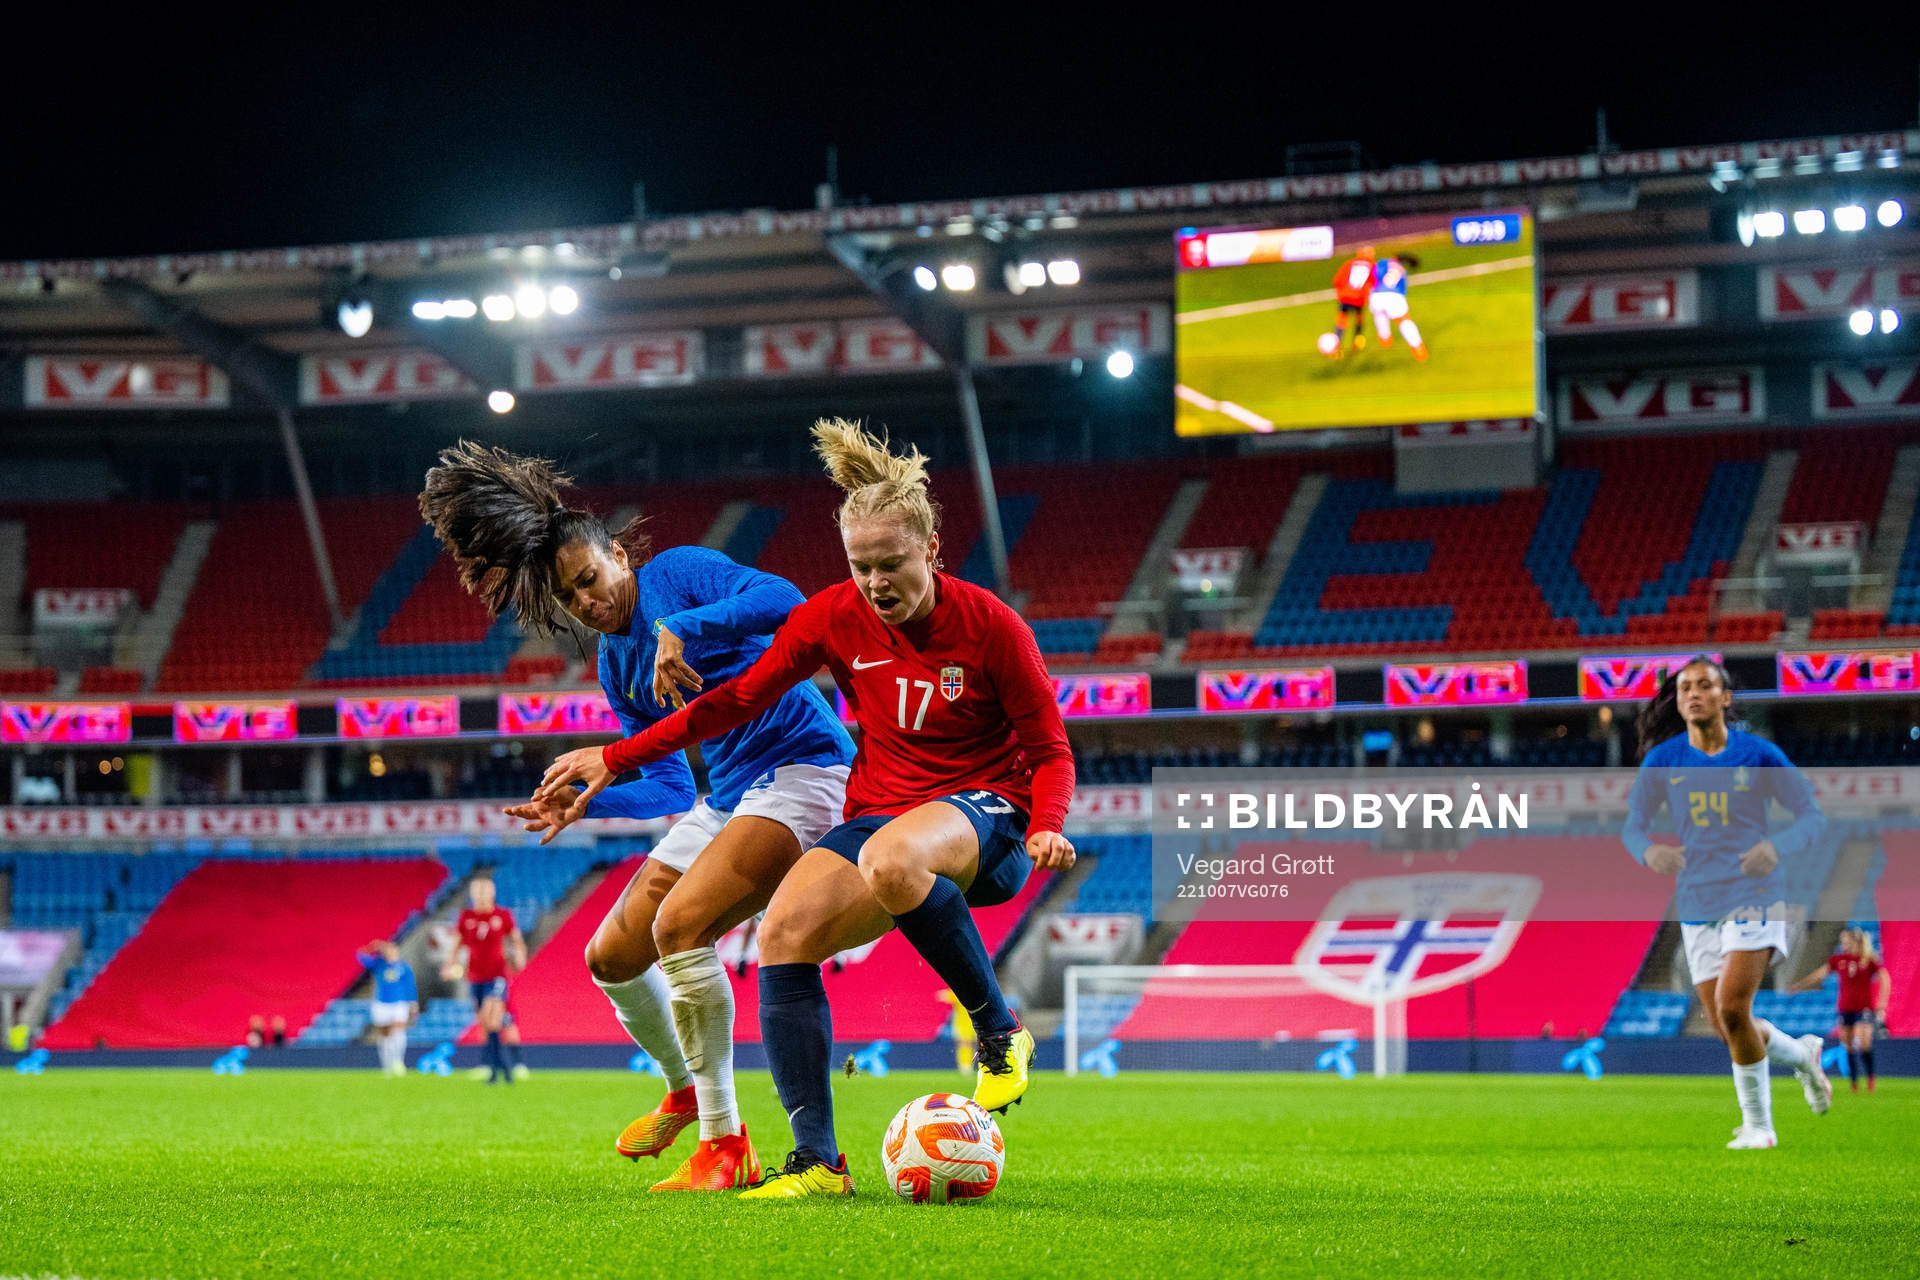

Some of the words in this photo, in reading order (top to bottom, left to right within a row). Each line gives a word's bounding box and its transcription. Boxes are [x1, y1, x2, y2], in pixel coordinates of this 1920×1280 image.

[767, 326, 915, 372] VG
[990, 313, 1142, 357] VG
[47, 360, 202, 399] VG
[537, 340, 679, 385] VG
[1572, 376, 1741, 419] VG
[1204, 671, 1323, 710] VG
[1389, 664, 1515, 704] VG
[1782, 653, 1914, 692] VG
[180, 703, 289, 741] VG
[342, 698, 450, 737] VG
[896, 677, 935, 731] 17
[1688, 791, 1729, 827] 24
